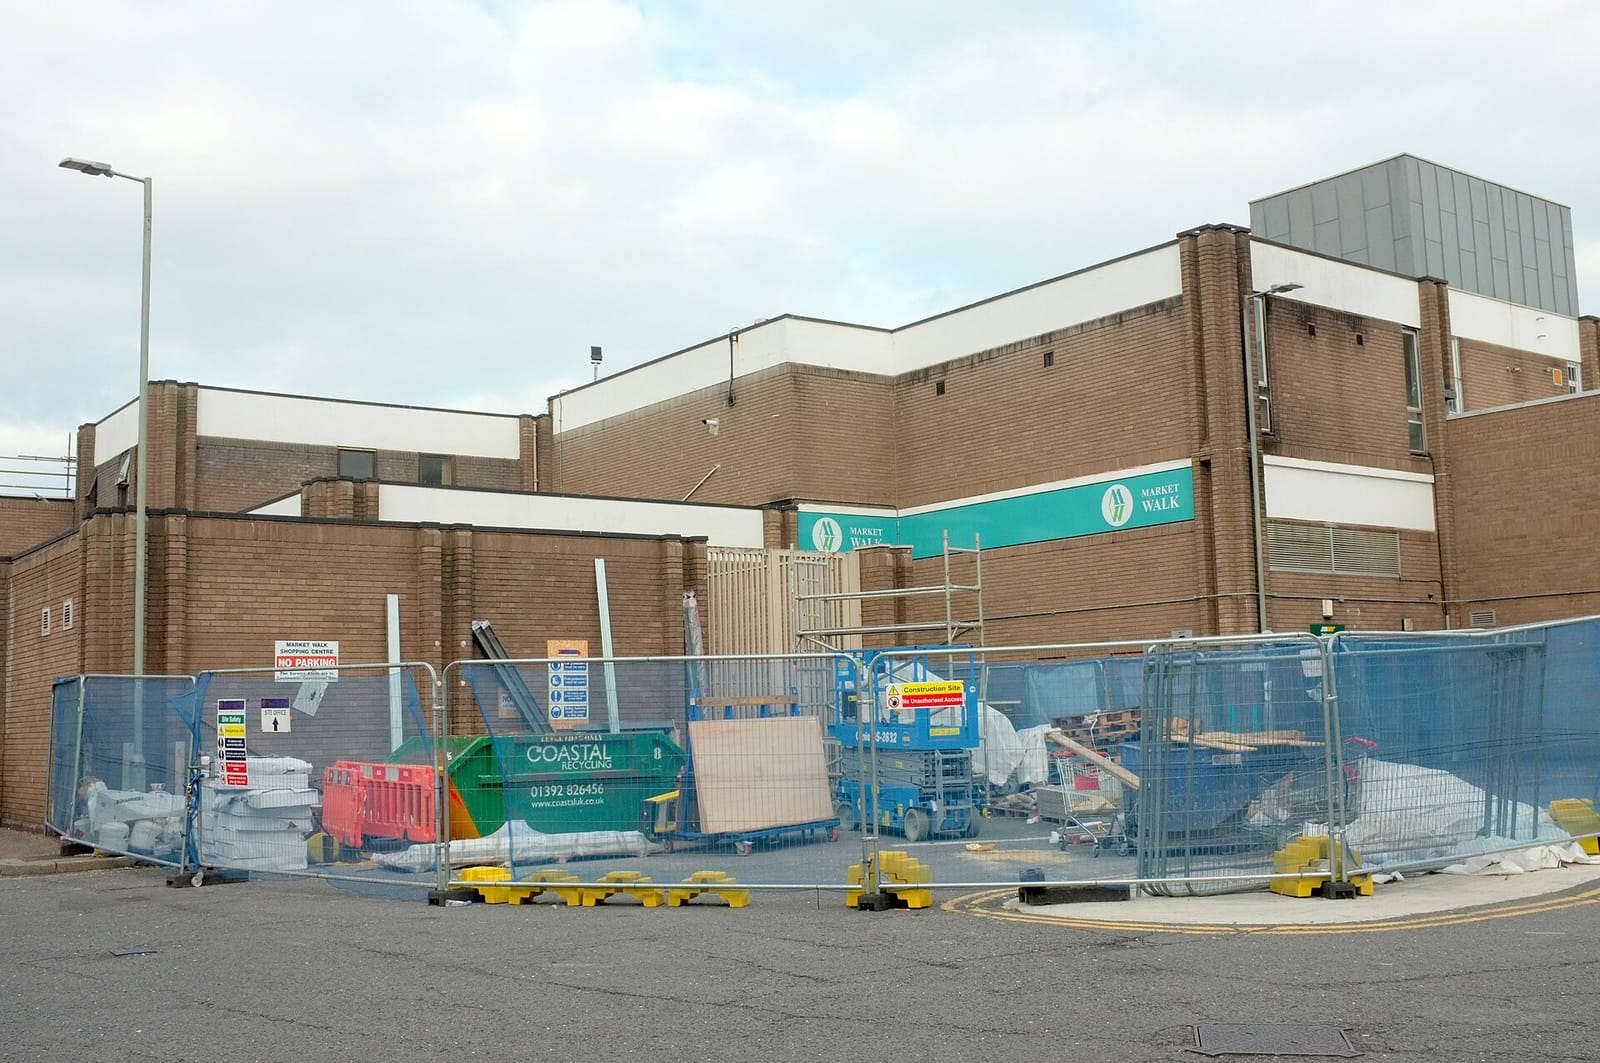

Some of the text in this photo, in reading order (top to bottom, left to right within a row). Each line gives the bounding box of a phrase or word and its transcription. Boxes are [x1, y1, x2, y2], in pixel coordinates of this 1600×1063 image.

[1141, 483, 1180, 497] MARKET
[1142, 495, 1180, 512] WALK
[849, 527, 883, 537] MARKET
[278, 658, 336, 668] NO PARKING
[526, 744, 612, 762] COASTAL
[561, 759, 612, 770] RECYCLING
[530, 783, 604, 798] 01392 826456
[531, 797, 604, 808] www.coastaluk.co.uk
